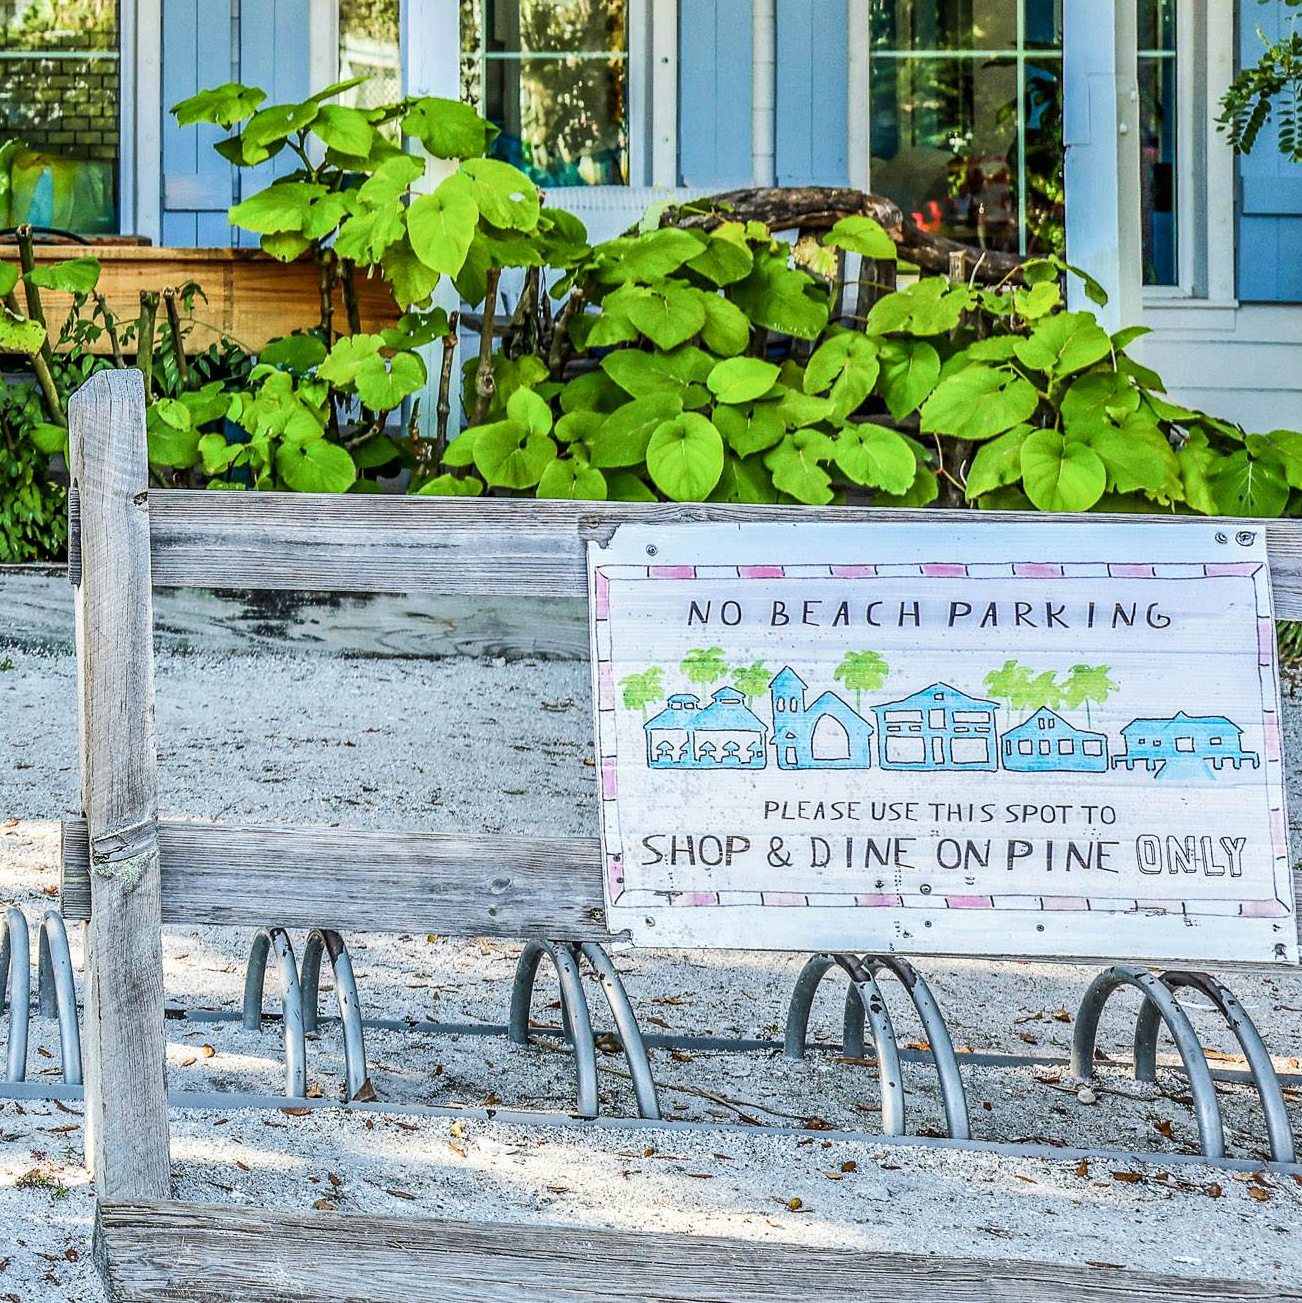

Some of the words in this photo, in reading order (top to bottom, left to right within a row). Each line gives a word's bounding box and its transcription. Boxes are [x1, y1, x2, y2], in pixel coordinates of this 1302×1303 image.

[687, 600, 742, 626] NO
[772, 600, 921, 627] BEACH
[949, 601, 1172, 629] PARKING
[763, 799, 861, 822] PLEASE
[870, 801, 917, 821] USE
[927, 801, 996, 823] THIS
[1005, 803, 1073, 825] SPOT
[1077, 803, 1117, 825] TO
[641, 834, 751, 868] SHOP
[766, 836, 793, 868] &
[810, 835, 918, 869] DINE
[936, 837, 993, 870] ON
[1006, 839, 1121, 875] PINE
[1135, 832, 1248, 878] ONLY
